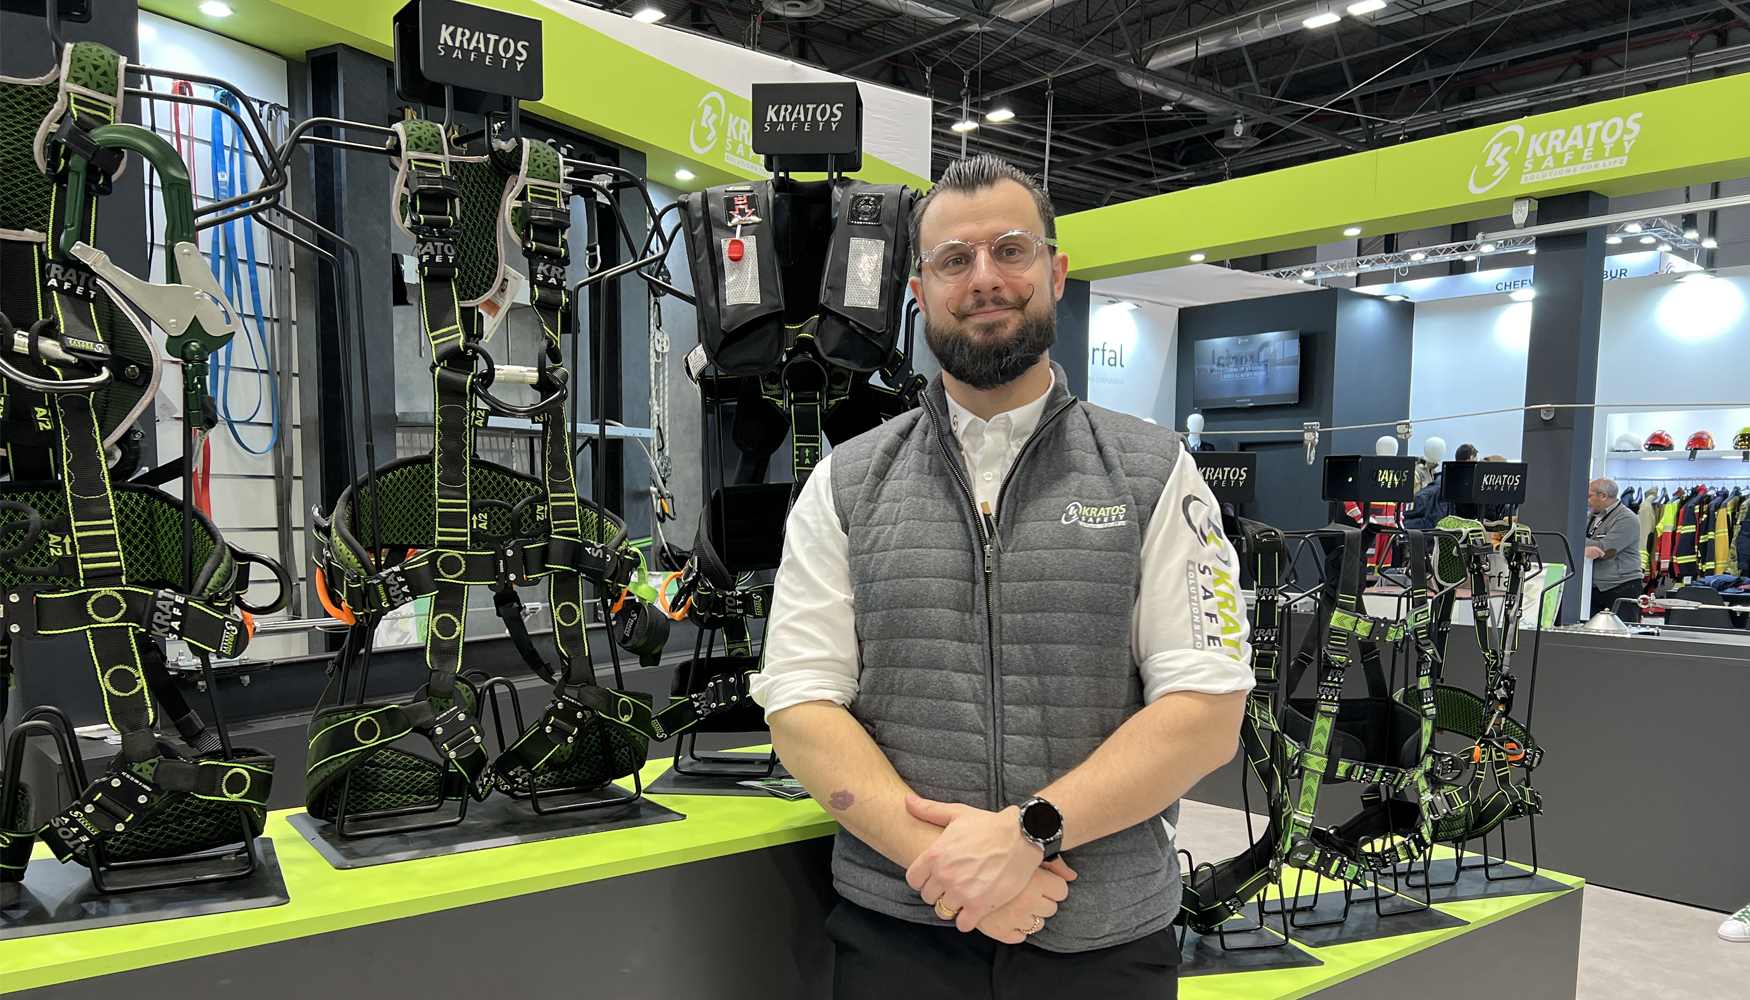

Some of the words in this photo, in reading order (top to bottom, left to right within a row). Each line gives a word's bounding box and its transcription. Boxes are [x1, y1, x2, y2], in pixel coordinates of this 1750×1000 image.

[440, 24, 529, 62] KRATOS
[437, 44, 524, 72] SAFETY
[766, 103, 844, 122] KRATOS
[727, 113, 753, 146] KR
[764, 122, 840, 132] SAFETY
[1526, 112, 1644, 159] KRATOS
[1523, 139, 1636, 173] SAFETY
[1523, 167, 1578, 182] SOLUTIONS
[1580, 164, 1599, 172] FOR
[1602, 158, 1625, 168] LIFE
[537, 262, 566, 280] KR
[1092, 341, 1124, 368] rfal
[474, 409, 486, 427] A/2
[1199, 467, 1248, 481] KRATOS
[1482, 474, 1521, 486] KRATOS
[478, 512, 488, 530] A/2
[536, 504, 545, 522] A/2
[1081, 514, 1125, 524] SAFETY
[1082, 503, 1127, 518] KRATOS
[48, 533, 63, 557] A/2
[1188, 563, 1201, 631] SOLUTIONS
[1198, 563, 1222, 648] SAFE
